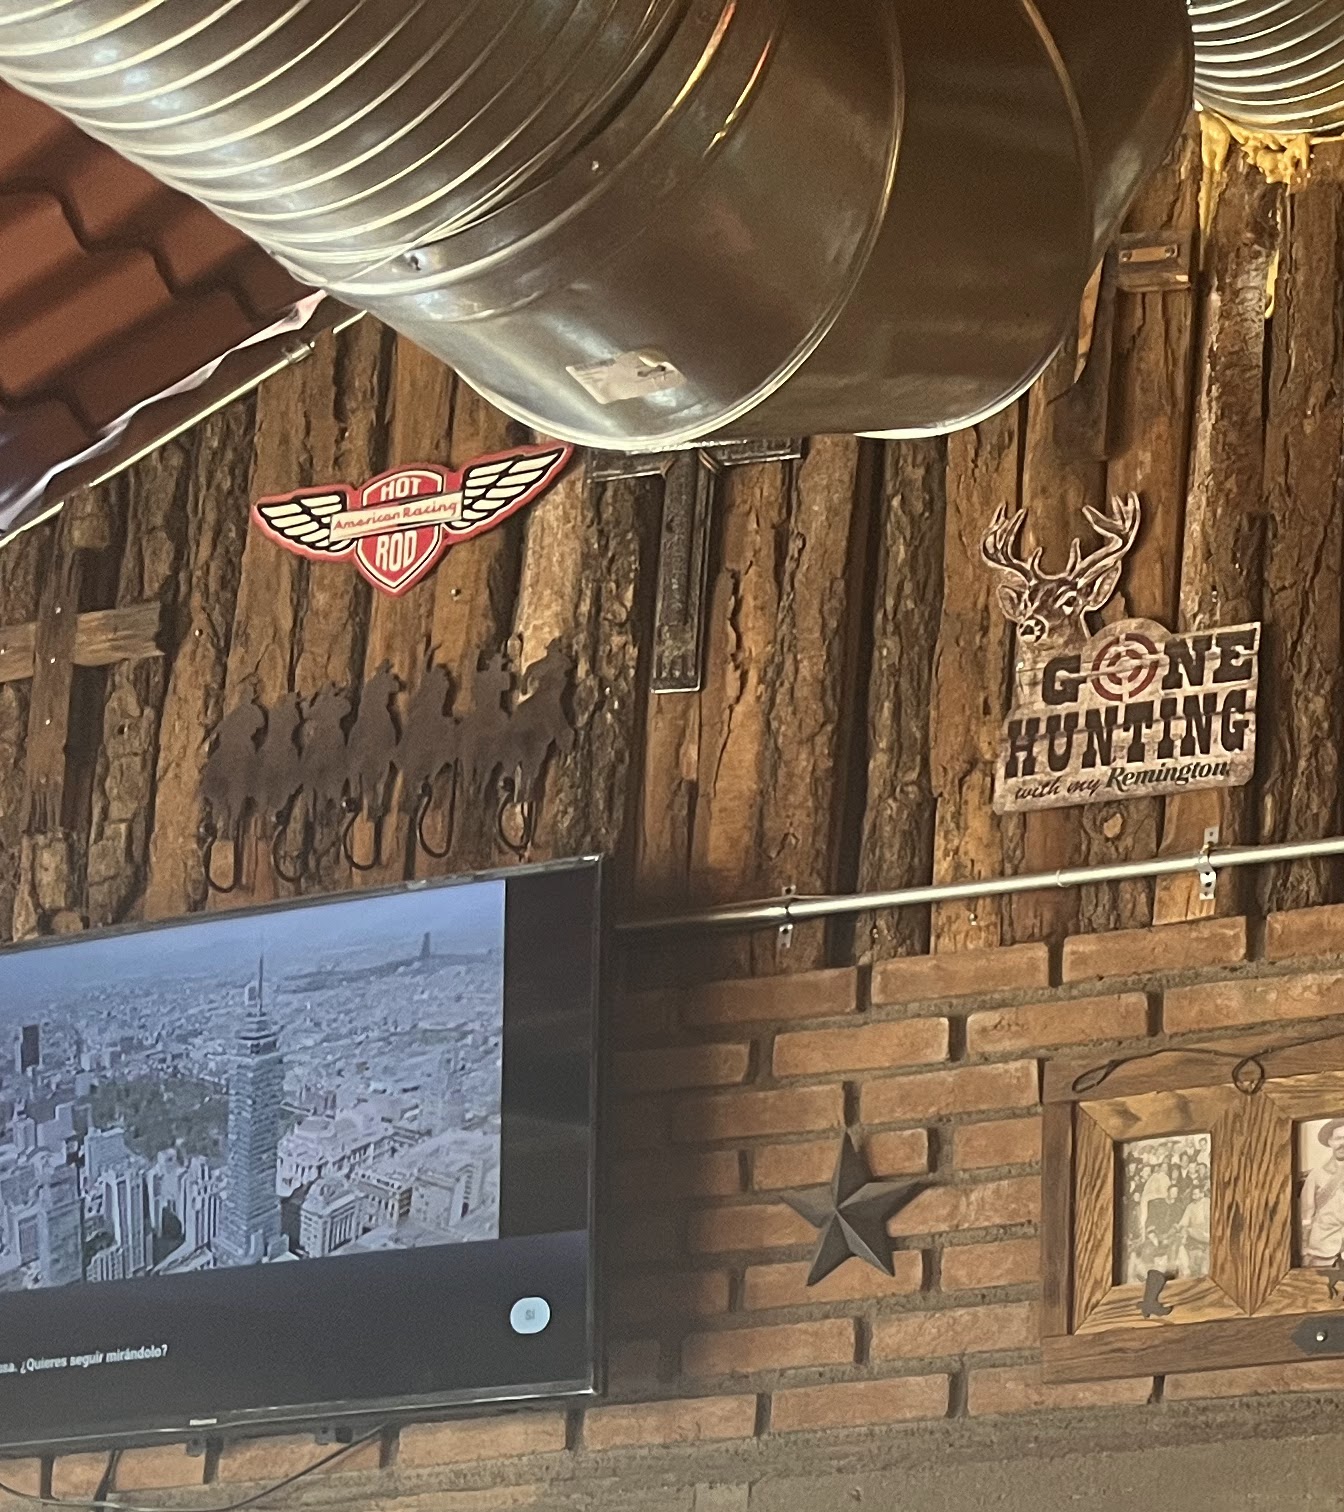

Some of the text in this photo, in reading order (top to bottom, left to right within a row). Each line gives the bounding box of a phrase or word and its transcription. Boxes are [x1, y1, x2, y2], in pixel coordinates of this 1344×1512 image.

[380, 476, 423, 502] HOT
[333, 499, 458, 530] American Racing
[375, 530, 419, 572] ROD
[1004, 688, 1250, 779] HUNTING
[1014, 775, 1061, 800] with
[1066, 776, 1100, 797] my
[70, 1351, 104, 1368] seguir
